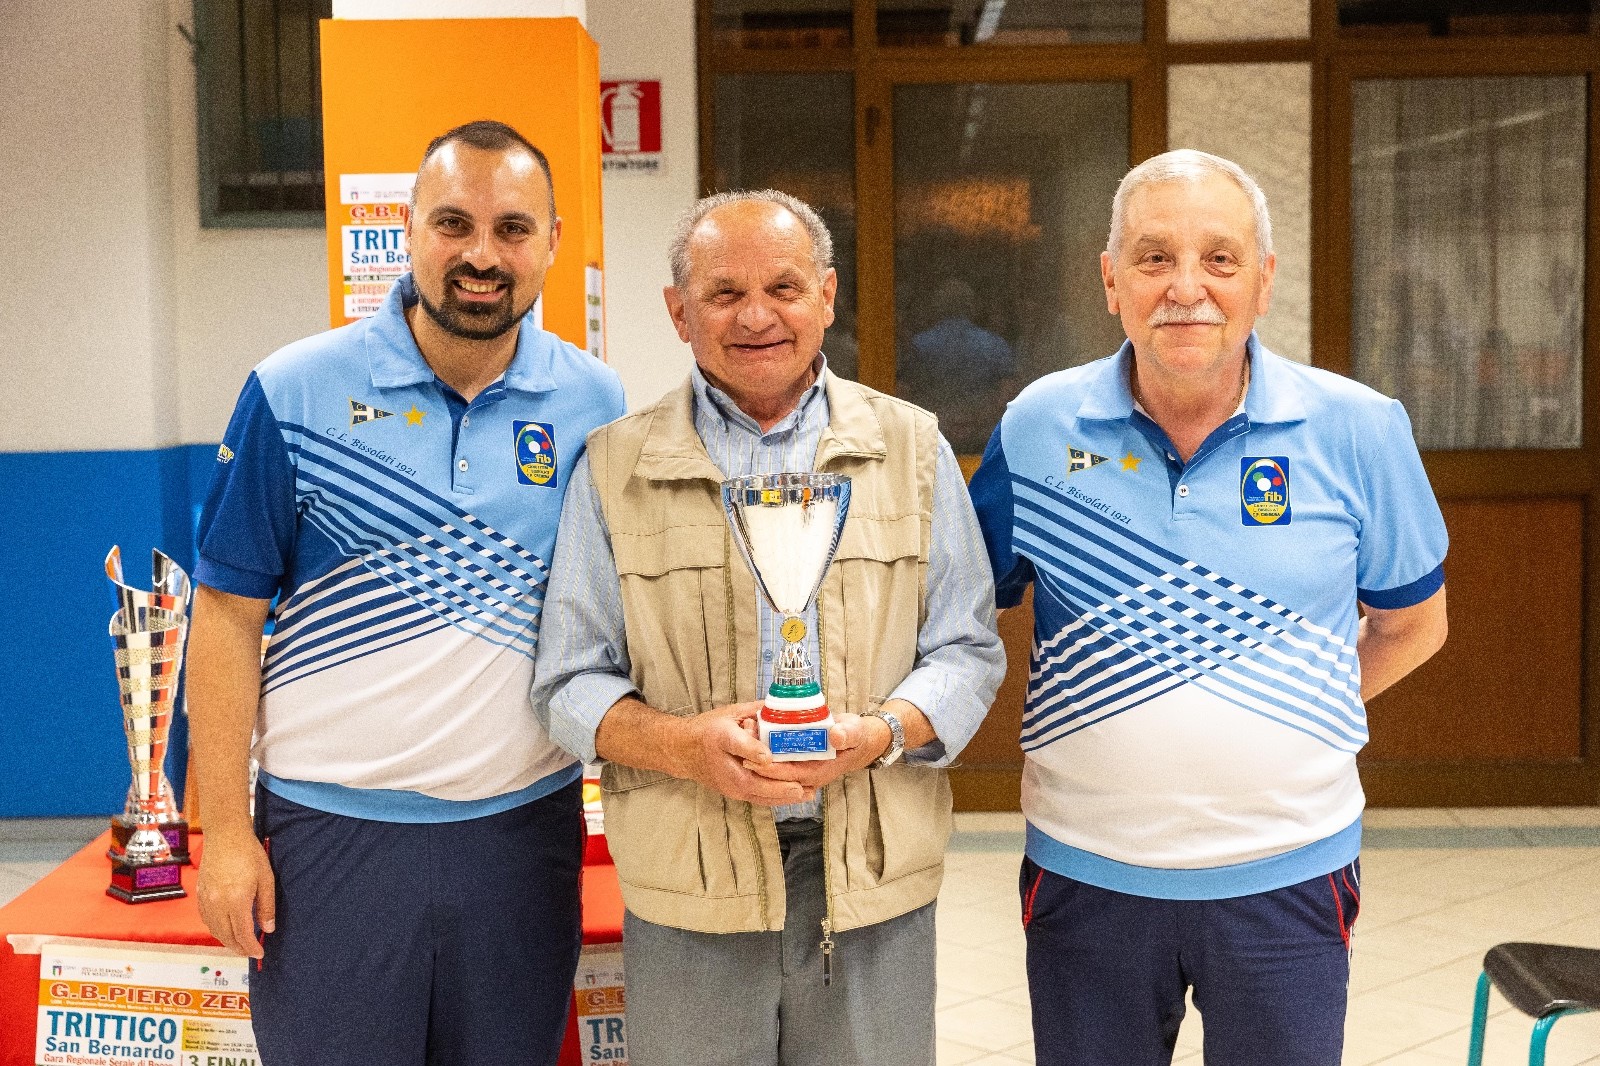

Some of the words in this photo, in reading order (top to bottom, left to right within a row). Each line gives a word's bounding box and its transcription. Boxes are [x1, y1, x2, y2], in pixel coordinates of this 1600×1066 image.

[350, 229, 404, 249] TRIT
[351, 252, 379, 263] San
[326, 427, 336, 436] C.
[337, 432, 347, 442] L.
[350, 438, 397, 465] Bissolati
[395, 462, 417, 476] 1921
[536, 453, 551, 463] fib
[1044, 475, 1054, 485] C.
[1055, 481, 1064, 490] L.
[1066, 486, 1111, 513] Bissolati
[1110, 510, 1132, 524] 1921
[1264, 491, 1283, 502] fib
[51, 983, 192, 1006] G.B.PIERO
[47, 1010, 177, 1044] TRITTICO
[586, 1018, 625, 1044] TR
[45, 1037, 80, 1053] San
[88, 1039, 175, 1059] Bernardo
[590, 1045, 625, 1060] San
[44, 1054, 64, 1063] Gara
[67, 1055, 107, 1066] Regionale
